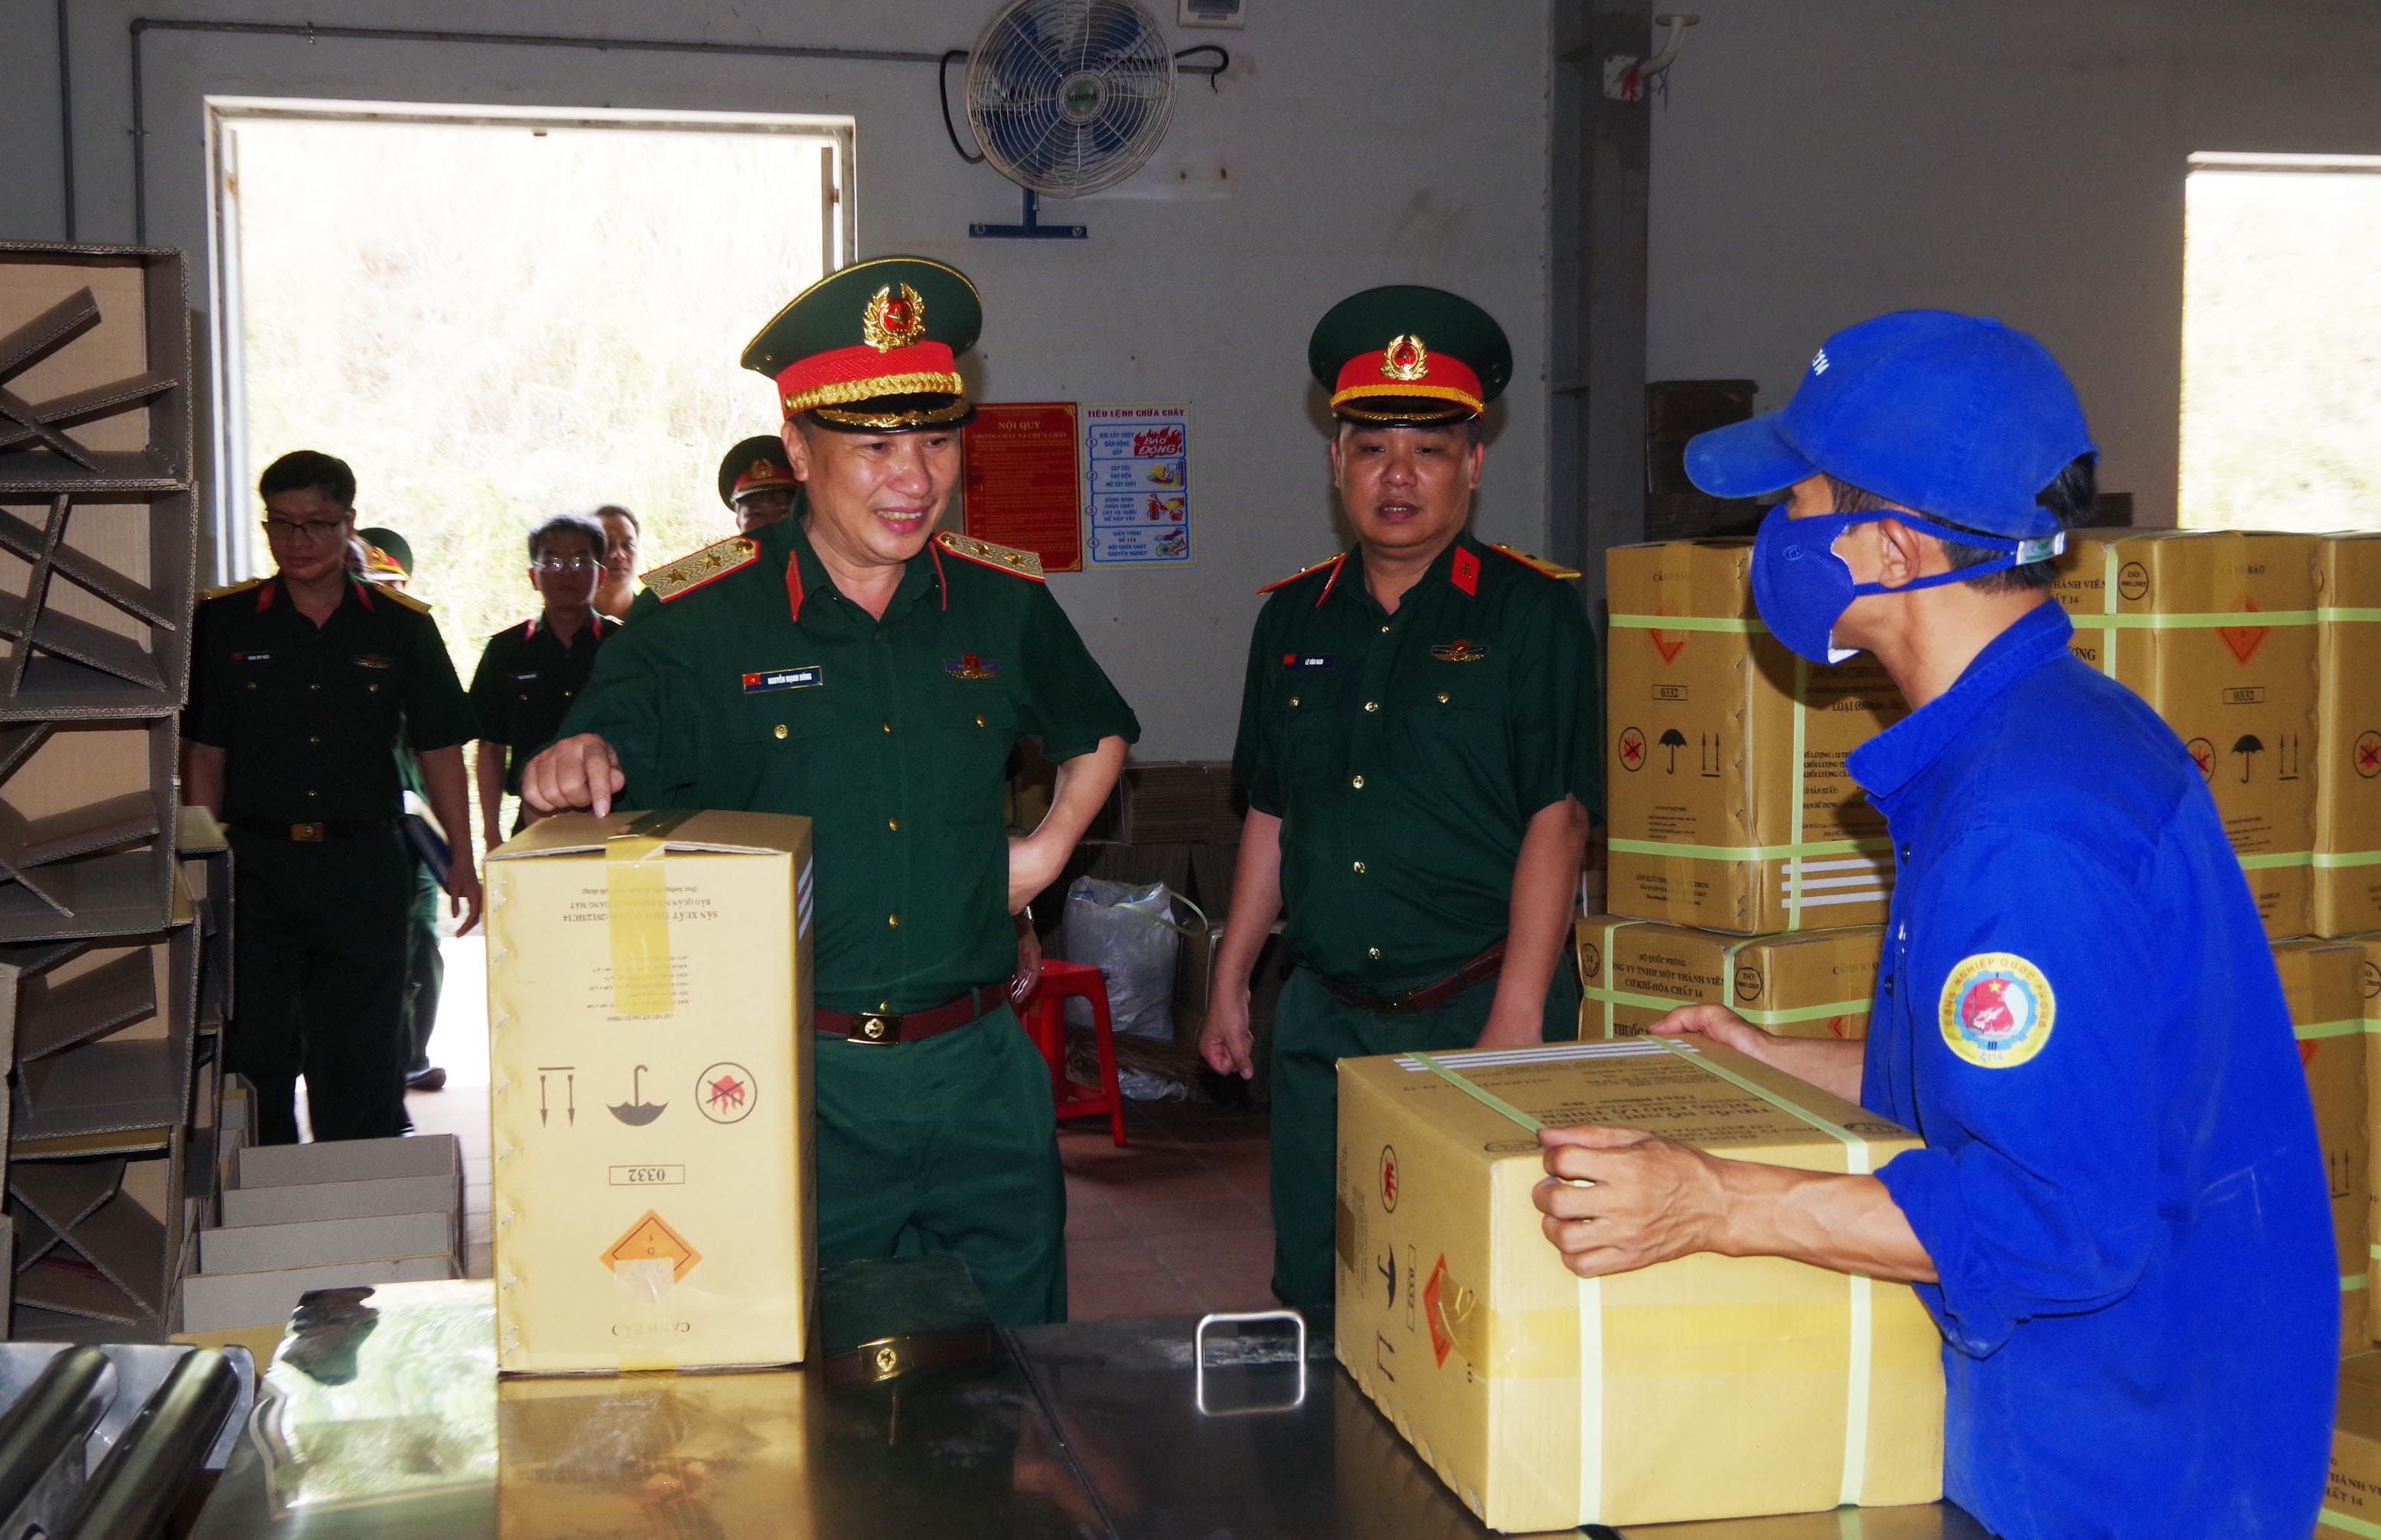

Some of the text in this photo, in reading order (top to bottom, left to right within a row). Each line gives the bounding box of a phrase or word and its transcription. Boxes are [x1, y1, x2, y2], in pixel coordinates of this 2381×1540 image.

[1088, 408, 1185, 419] TIÊU LỆNH CHỮA CHÁY
[998, 420, 1016, 431] NỘI
[2070, 595, 2079, 604] 14
[1660, 687, 1678, 698] 0332
[2234, 690, 2254, 702] 0332
[1832, 701, 1853, 713] LOẠI
[674, 911, 700, 923] XUẤT
[700, 910, 719, 922] SẢN
[1639, 953, 1687, 967] BỘ QUỐC PHÒNG
[1613, 961, 1624, 972] ÔNG
[1626, 964, 1636, 973] TY
[1637, 966, 1658, 977] TNHH
[1658, 969, 1675, 980] MỘT
[1676, 969, 1705, 984] THÀNH
[1743, 972, 1754, 980] ISO
[1625, 977, 1636, 987] CƠ
[1671, 984, 1693, 998] CHẤT
[1694, 989, 1703, 999] 14
[1613, 1023, 1644, 1037] THUỐC
[628, 1168, 666, 1183] 0332
[2329, 1471, 2366, 1493] HÀNH
[2351, 1495, 2363, 1507] 14
